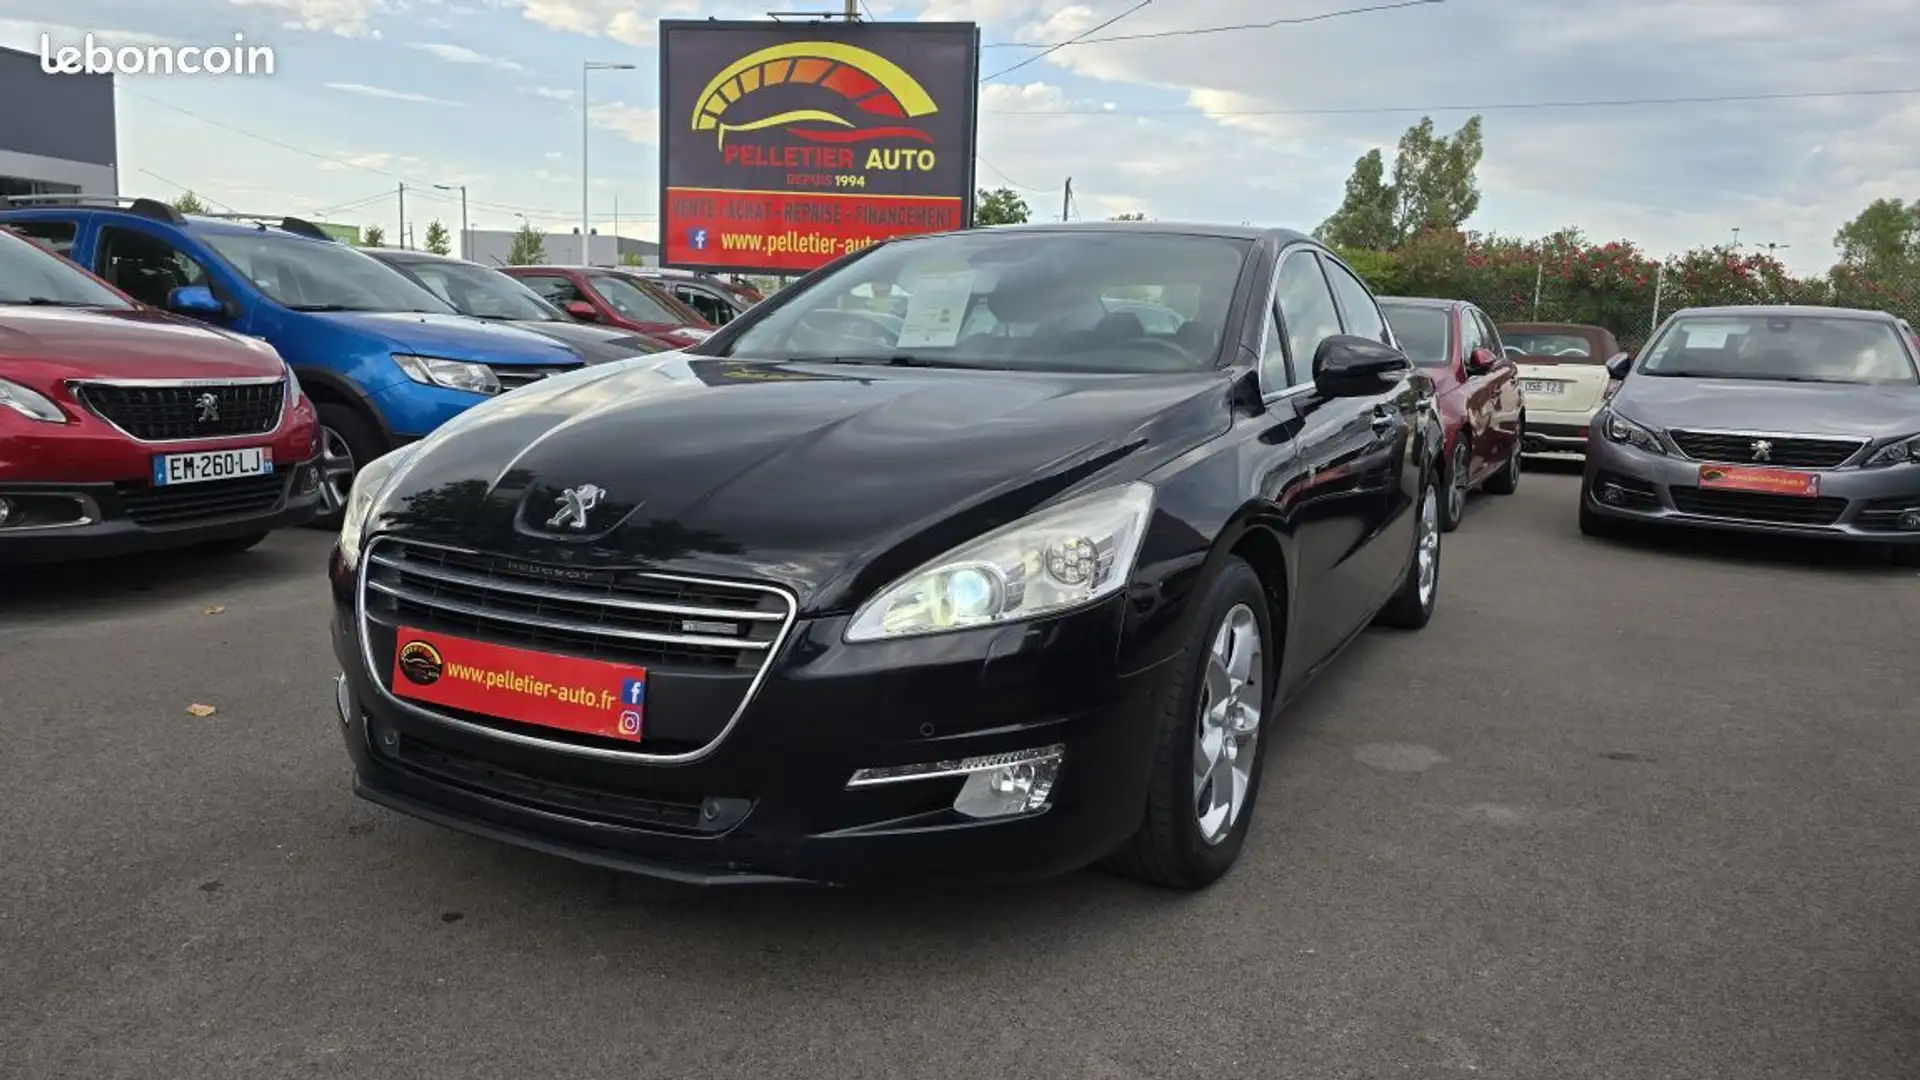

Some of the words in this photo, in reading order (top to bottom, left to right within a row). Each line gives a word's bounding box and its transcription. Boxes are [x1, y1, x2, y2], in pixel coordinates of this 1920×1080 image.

[724, 145, 854, 169] PELLETIER
[865, 148, 936, 171] AUTO
[787, 173, 833, 187] DEPUIS
[835, 174, 866, 188] 1994
[673, 198, 715, 218] VENTE
[727, 199, 771, 221] ACHAT
[784, 201, 842, 225] REPRISE
[854, 204, 955, 227] FINANCEMENT
[721, 231, 881, 256] www.pelletier-aut
[170, 450, 261, 481] EM-260-LJ
[447, 660, 617, 711] www.pelletier-auto.fr
